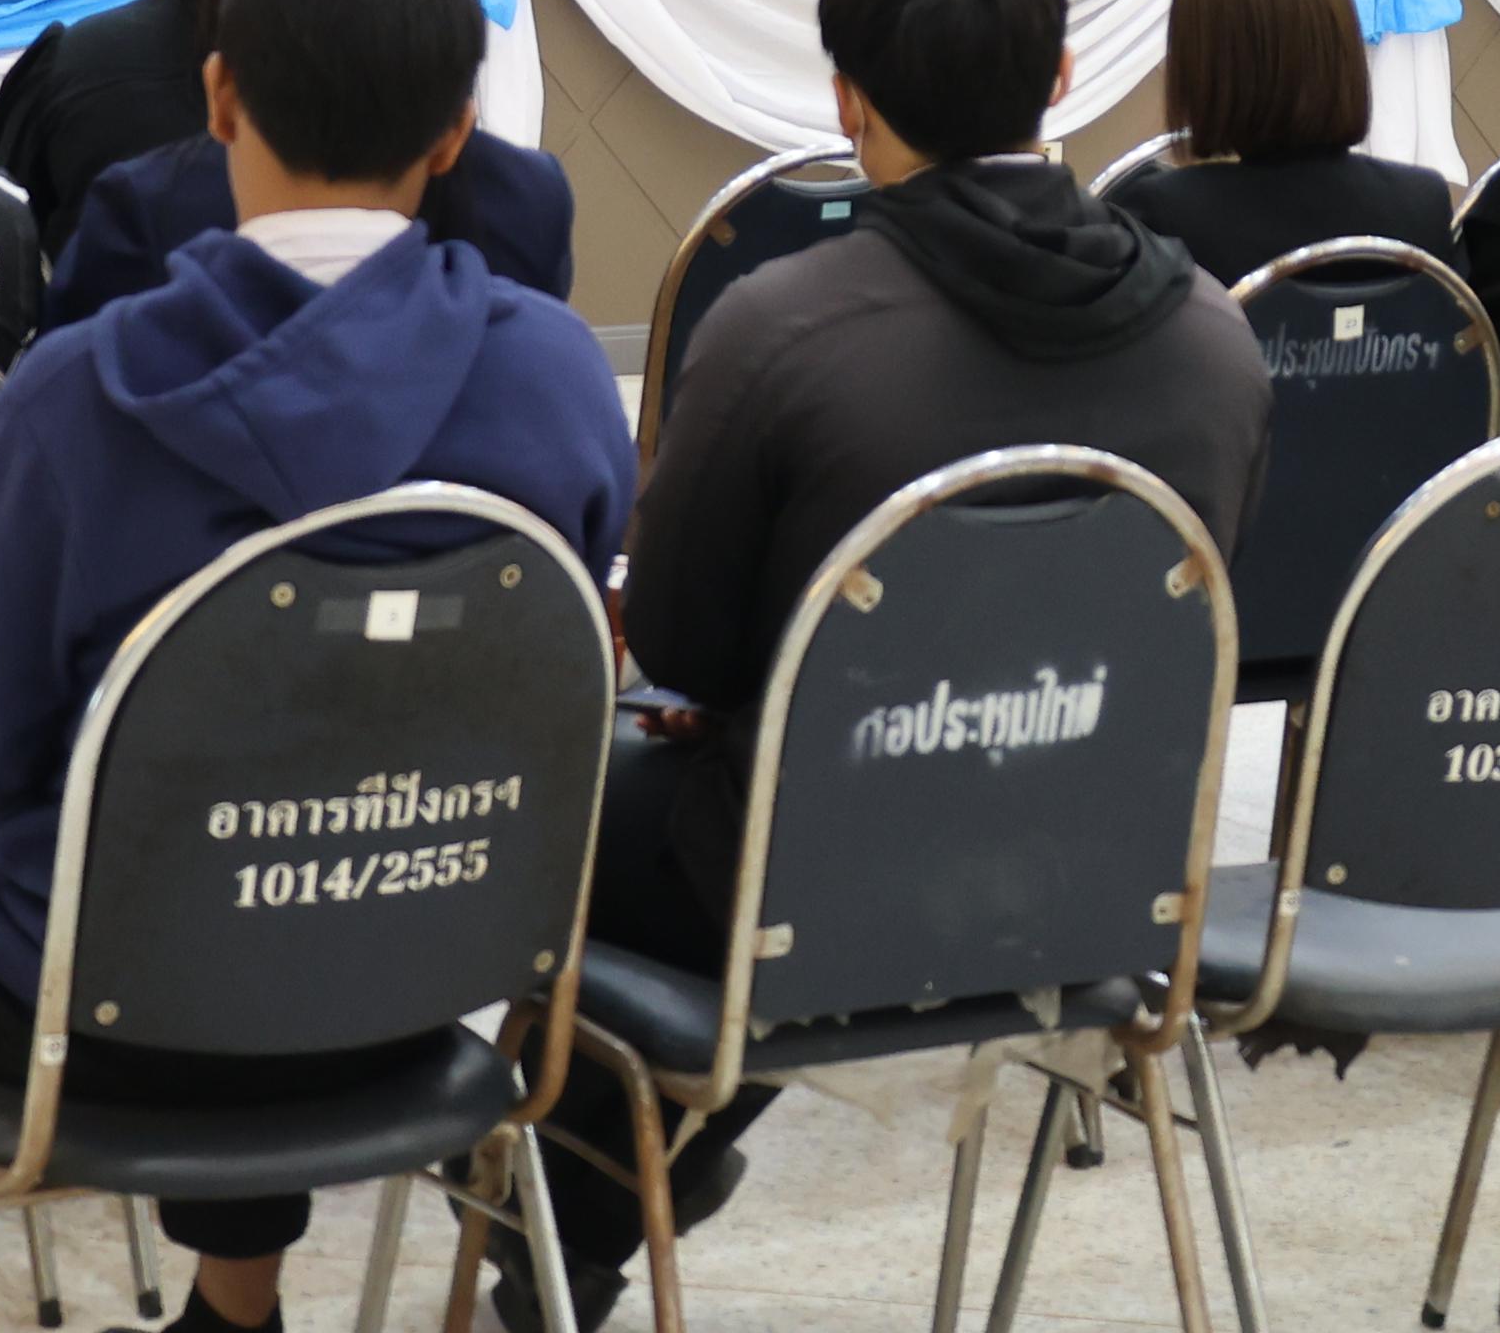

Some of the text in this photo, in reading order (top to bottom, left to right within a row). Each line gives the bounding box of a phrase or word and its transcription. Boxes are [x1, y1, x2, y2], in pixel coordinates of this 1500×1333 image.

[205, 770, 524, 841] อาคารทีปังกรฯ
[234, 837, 491, 910] 1014/2555
